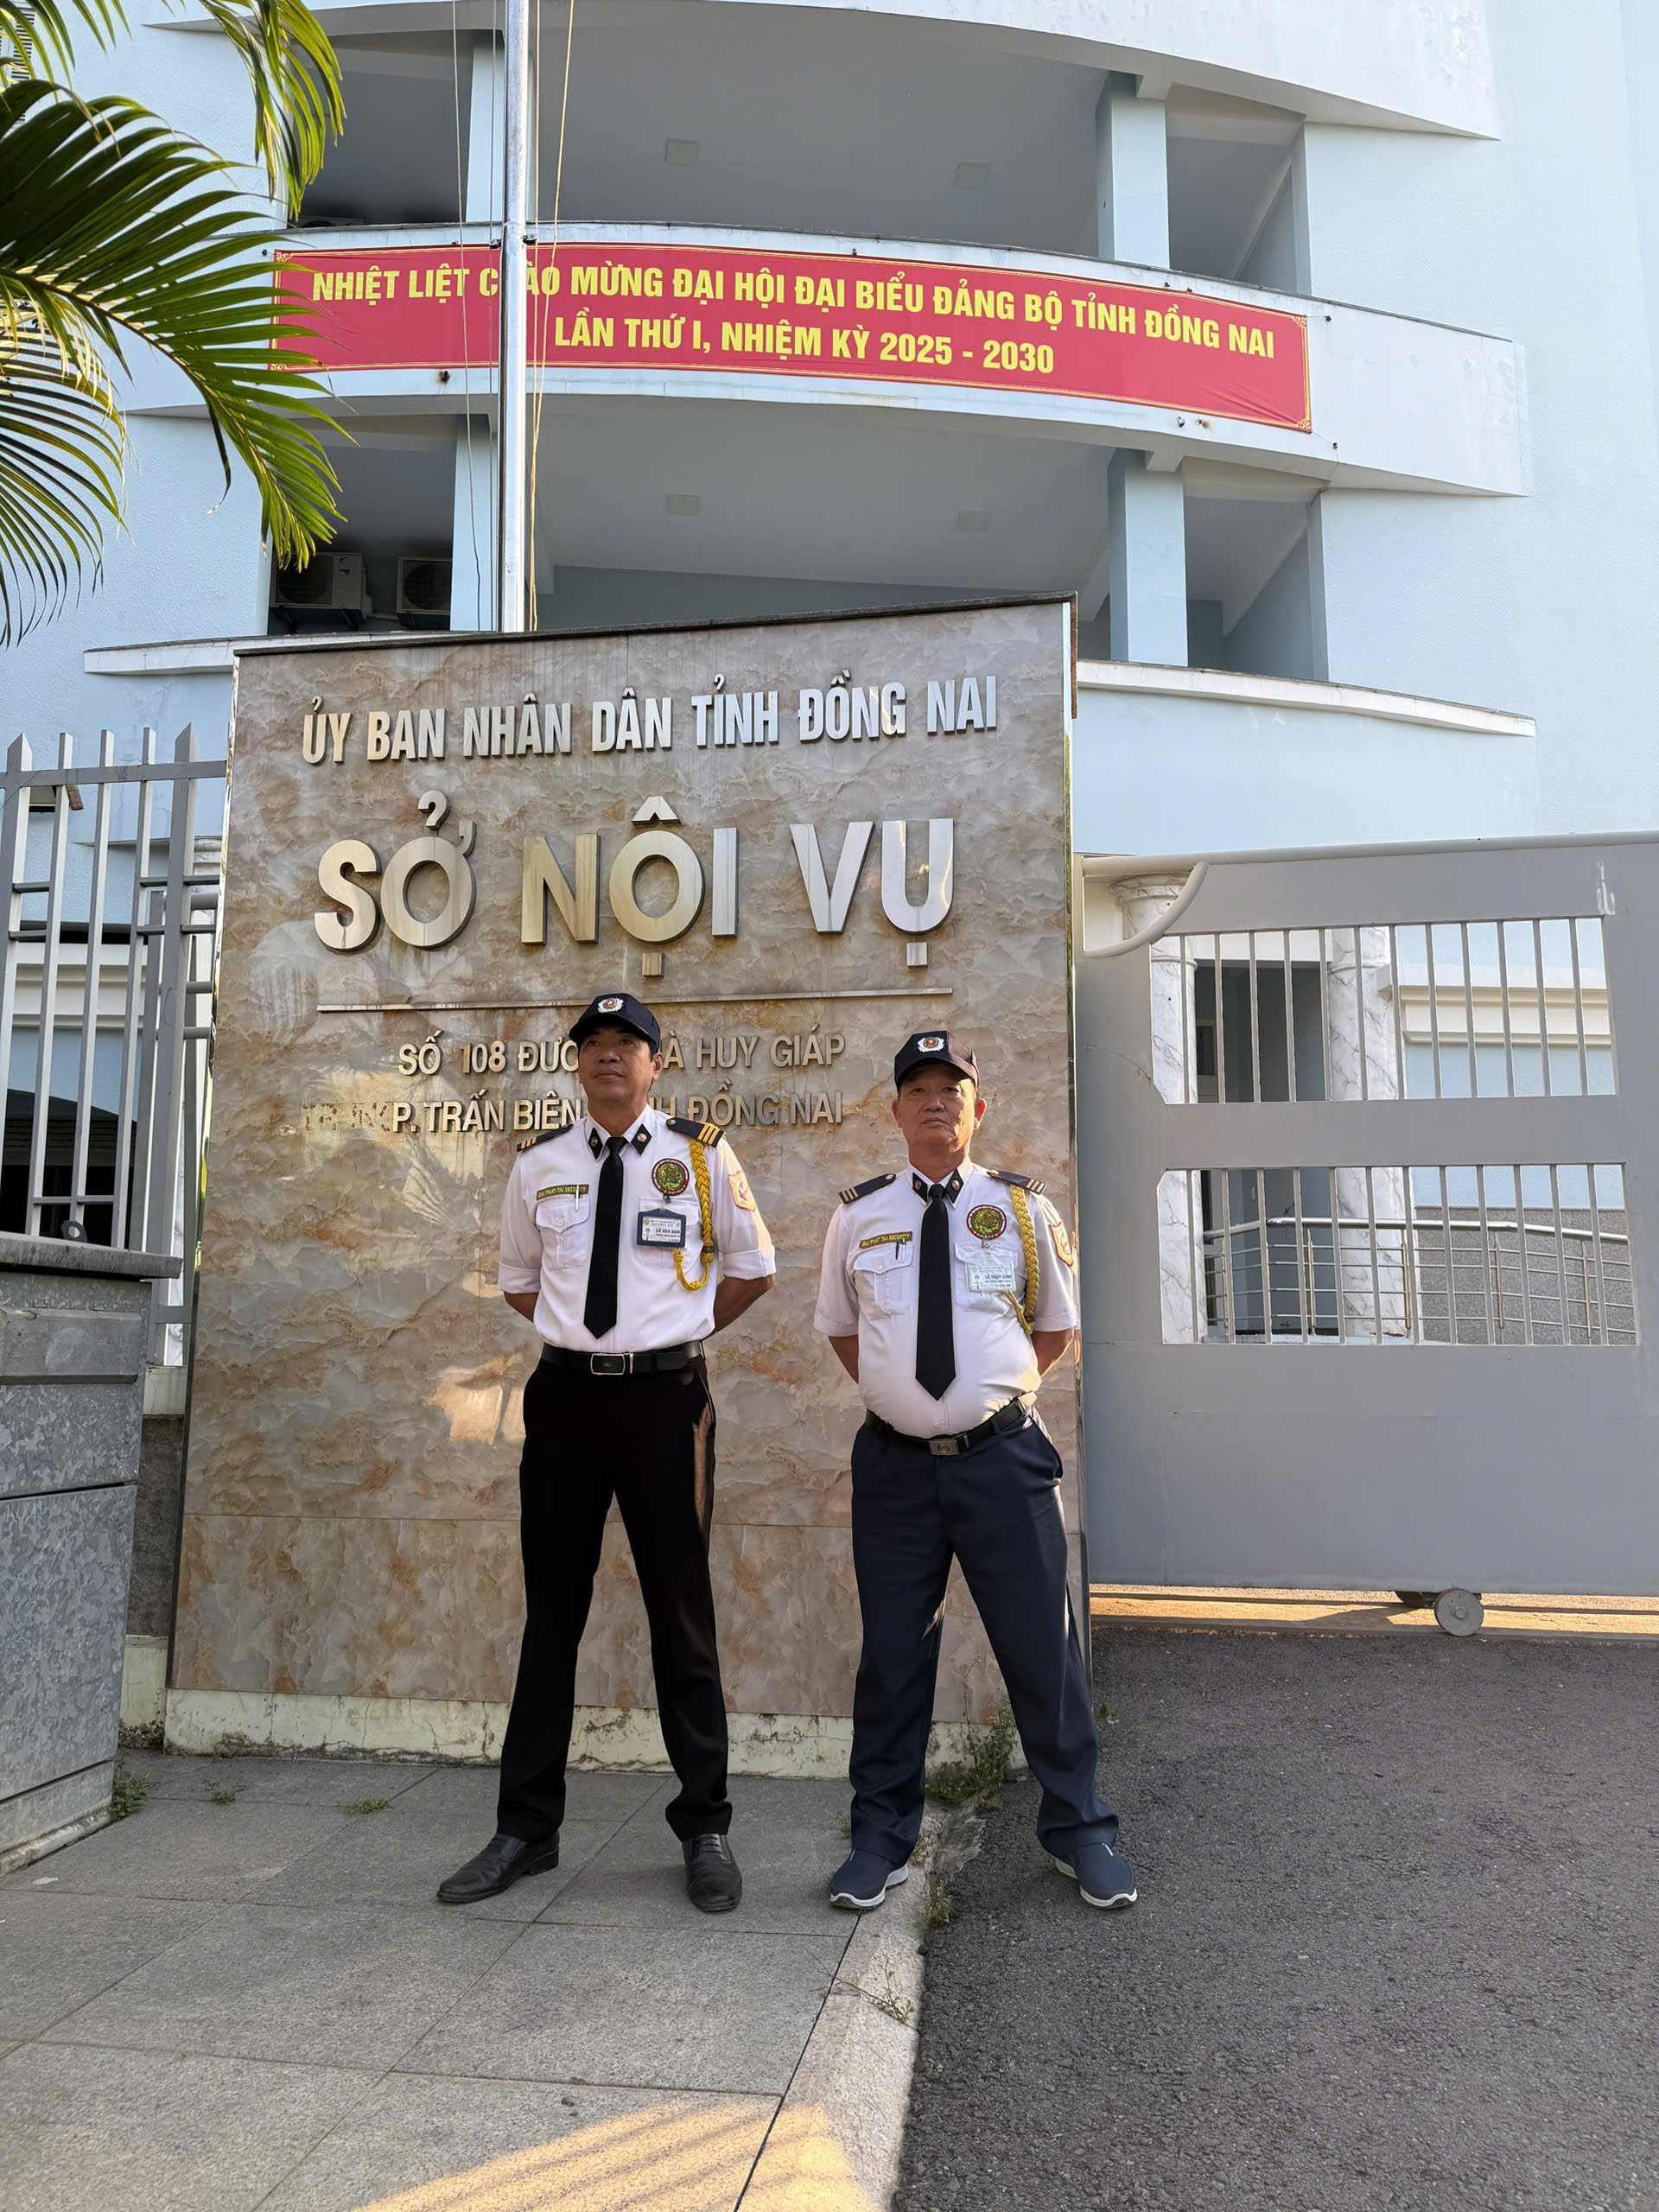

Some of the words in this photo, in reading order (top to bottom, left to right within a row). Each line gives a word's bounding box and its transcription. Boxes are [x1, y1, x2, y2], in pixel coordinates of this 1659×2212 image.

[313, 264, 400, 306] NHIỆT
[409, 263, 470, 304] LIỆT
[480, 261, 560, 297] CÀO
[571, 260, 663, 298] MỪNG
[672, 268, 724, 306] ĐẠI
[734, 267, 785, 309] HỘI
[794, 276, 845, 312] ĐẠI
[855, 270, 924, 313] BIỂU
[933, 278, 1015, 320] ĐẢNG
[1025, 290, 1063, 333] BỘ
[1071, 292, 1136, 334] TỈNH
[1144, 303, 1220, 350] ĐỒNG
[1228, 323, 1275, 359] NAI
[555, 307, 614, 347] LẦN
[625, 312, 687, 349] THỨ
[693, 321, 711, 353] I,
[721, 319, 822, 360] NHIỆM
[831, 325, 869, 359] KỲ
[880, 332, 953, 366] 2025
[982, 340, 1054, 374] 2030
[302, 696, 352, 765] ỦY
[366, 708, 446, 761] BAN
[462, 691, 573, 758] NHÂN
[592, 687, 672, 753] DÂN
[691, 673, 779, 748] TỈNH
[798, 669, 906, 741] ĐỒNG
[926, 676, 996, 735] NAI
[314, 790, 477, 952] SỞ
[521, 796, 739, 978] NỘI
[790, 818, 954, 969] VỤ
[397, 1029, 444, 1076] SỐ
[459, 1040, 507, 1074] 108
[659, 1030, 685, 1069] À
[696, 1036, 760, 1068] HUY
[770, 1023, 846, 1068] GIÁP
[392, 1101, 419, 1133] P.
[423, 1088, 505, 1133] TRẤN
[513, 1090, 582, 1131] BIÊN
[687, 1078, 779, 1127] ĐỒNG
[790, 1091, 844, 1124] NAI
